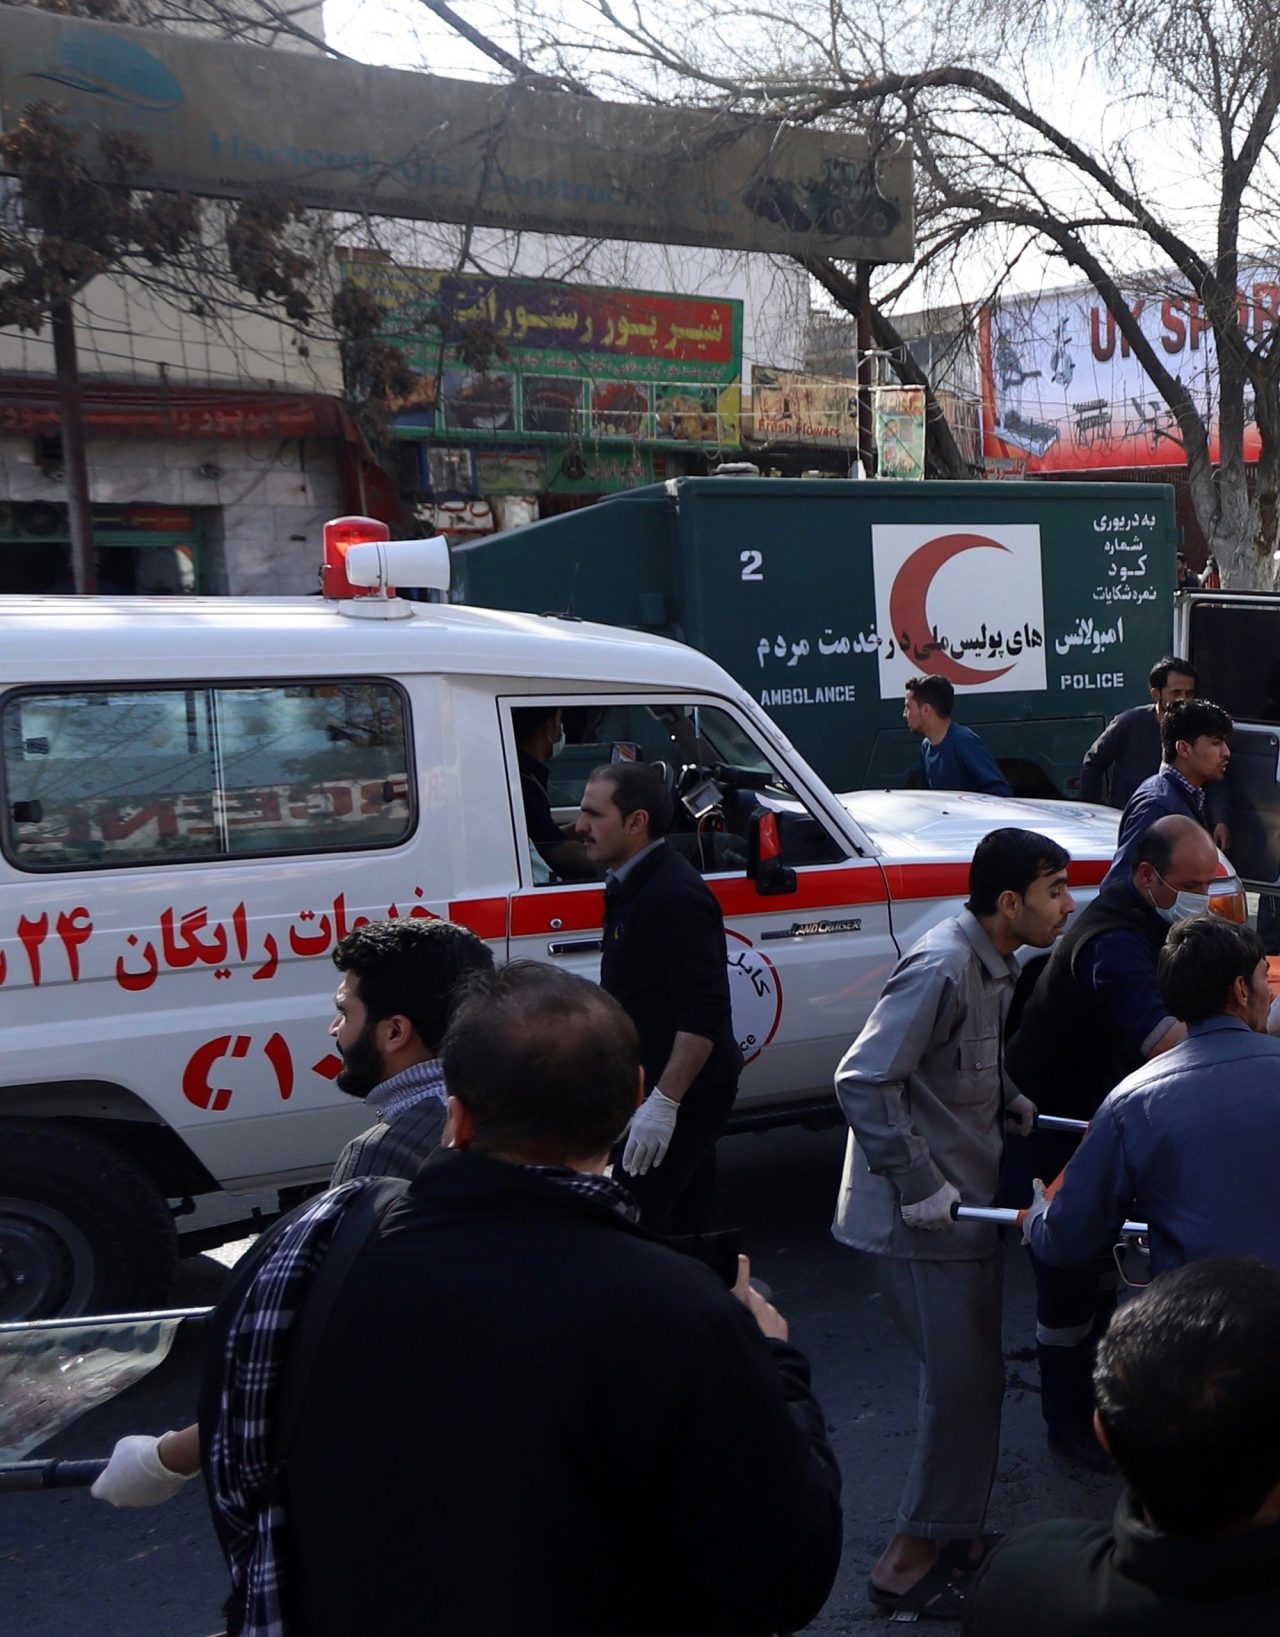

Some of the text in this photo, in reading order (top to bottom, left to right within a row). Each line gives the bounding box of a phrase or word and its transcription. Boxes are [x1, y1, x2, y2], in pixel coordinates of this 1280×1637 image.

[740, 550, 764, 581] 2
[1108, 554, 1148, 581] کود
[1060, 672, 1125, 690] POLICE
[760, 685, 856, 706] AMBOLANCE
[115, 901, 279, 991] رایگان
